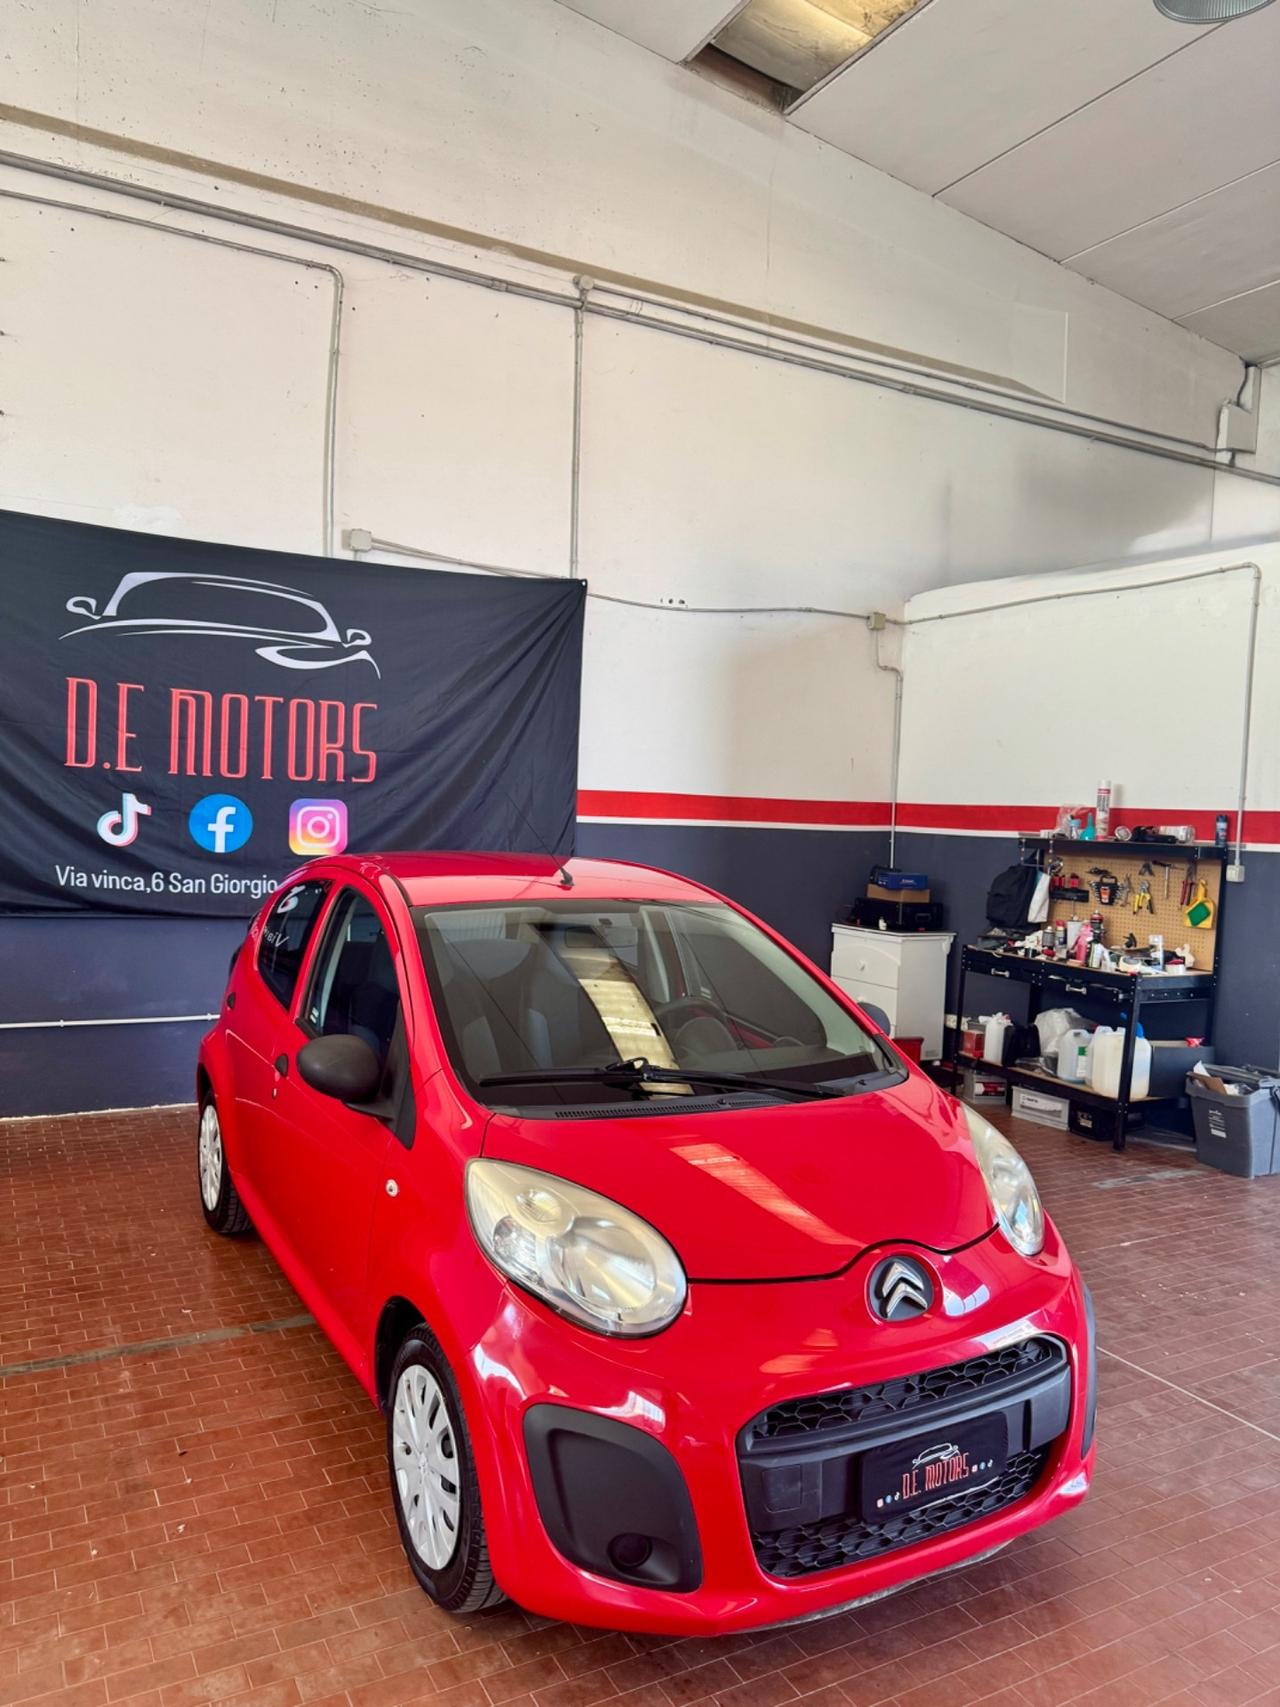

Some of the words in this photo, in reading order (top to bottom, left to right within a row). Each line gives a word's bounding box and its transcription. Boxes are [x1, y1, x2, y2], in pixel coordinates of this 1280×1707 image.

[64, 677, 145, 772] D.E
[168, 688, 378, 783] MOTORS
[55, 865, 87, 888] Via
[93, 869, 164, 894] vinca,6
[168, 873, 205, 894] San
[210, 874, 278, 899] Giorgio
[925, 1452, 969, 1490] MOTORS
